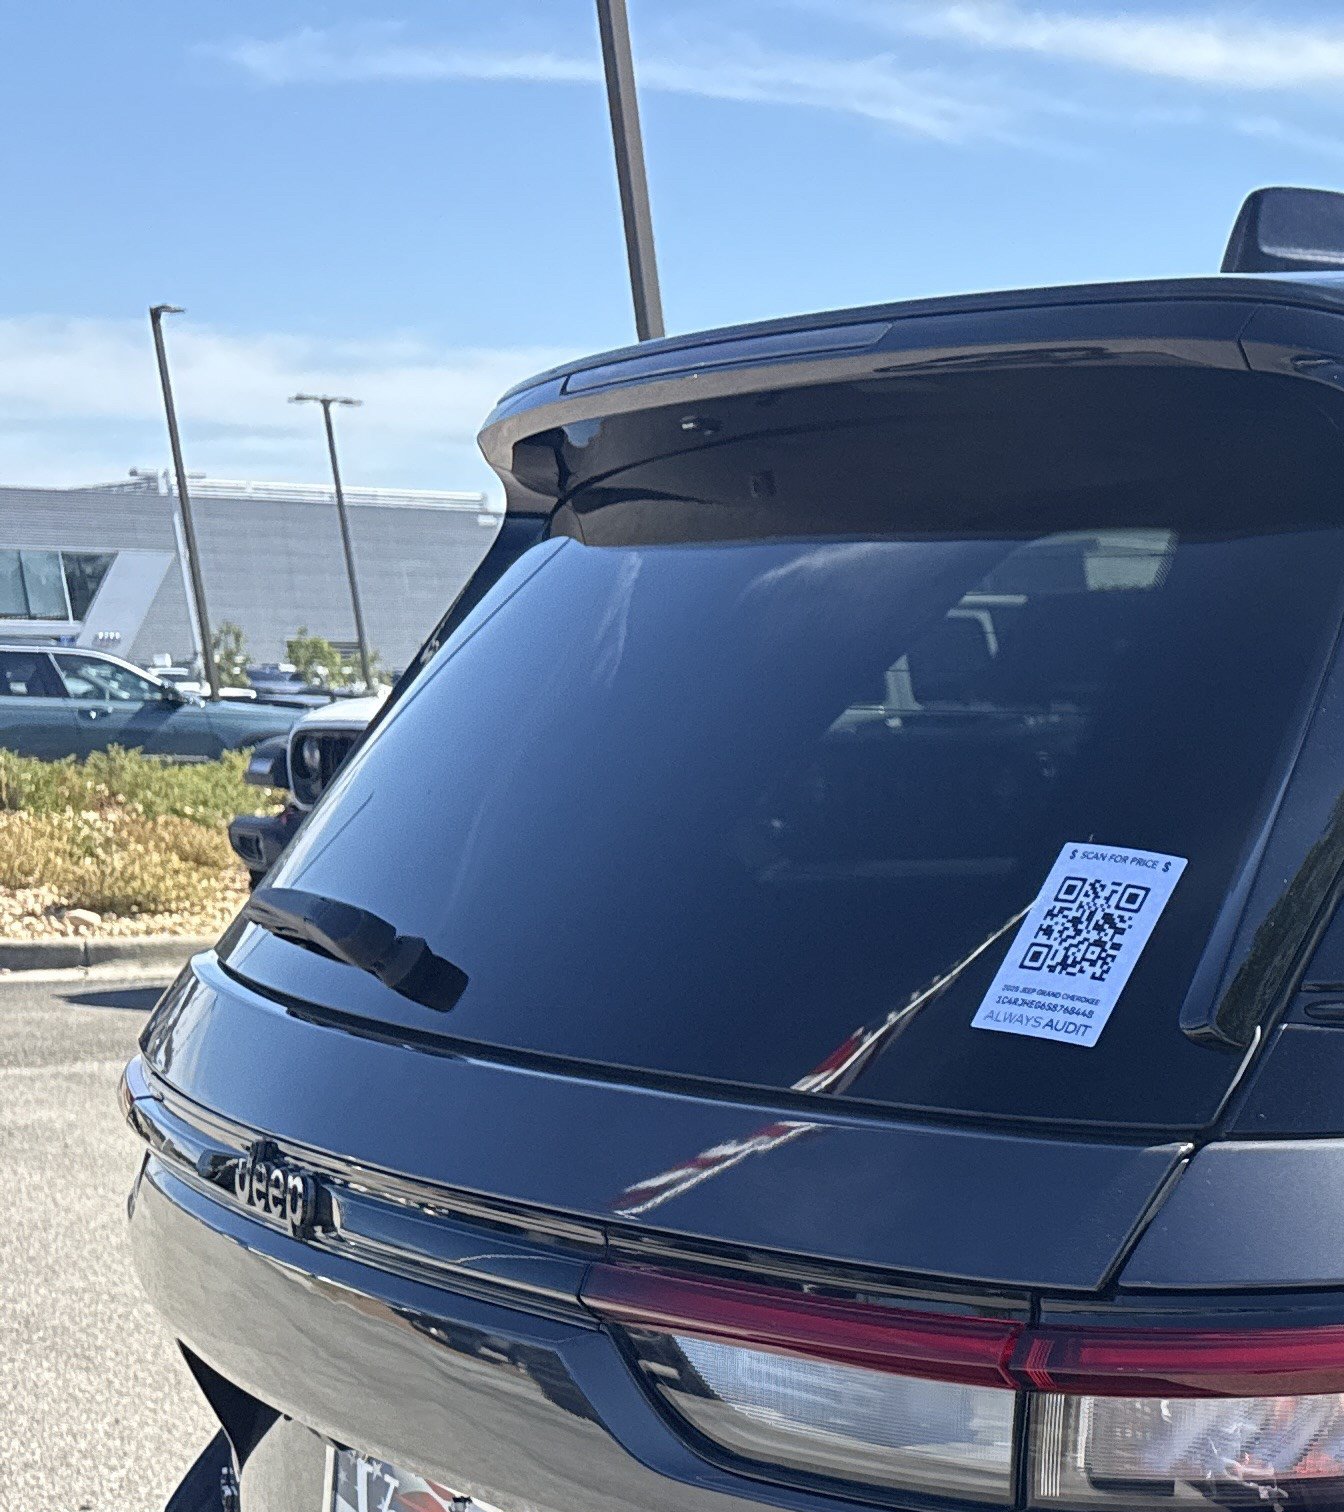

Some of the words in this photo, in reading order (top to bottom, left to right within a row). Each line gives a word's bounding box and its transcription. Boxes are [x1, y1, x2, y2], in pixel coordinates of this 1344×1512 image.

[1080, 850, 1107, 862] SCAN
[1108, 853, 1127, 865] FOR
[1129, 856, 1159, 870] PRICE
[984, 1009, 1044, 1029] ALWAYS
[1042, 1018, 1093, 1037] AUDIT
[234, 1157, 306, 1238] Jeep
